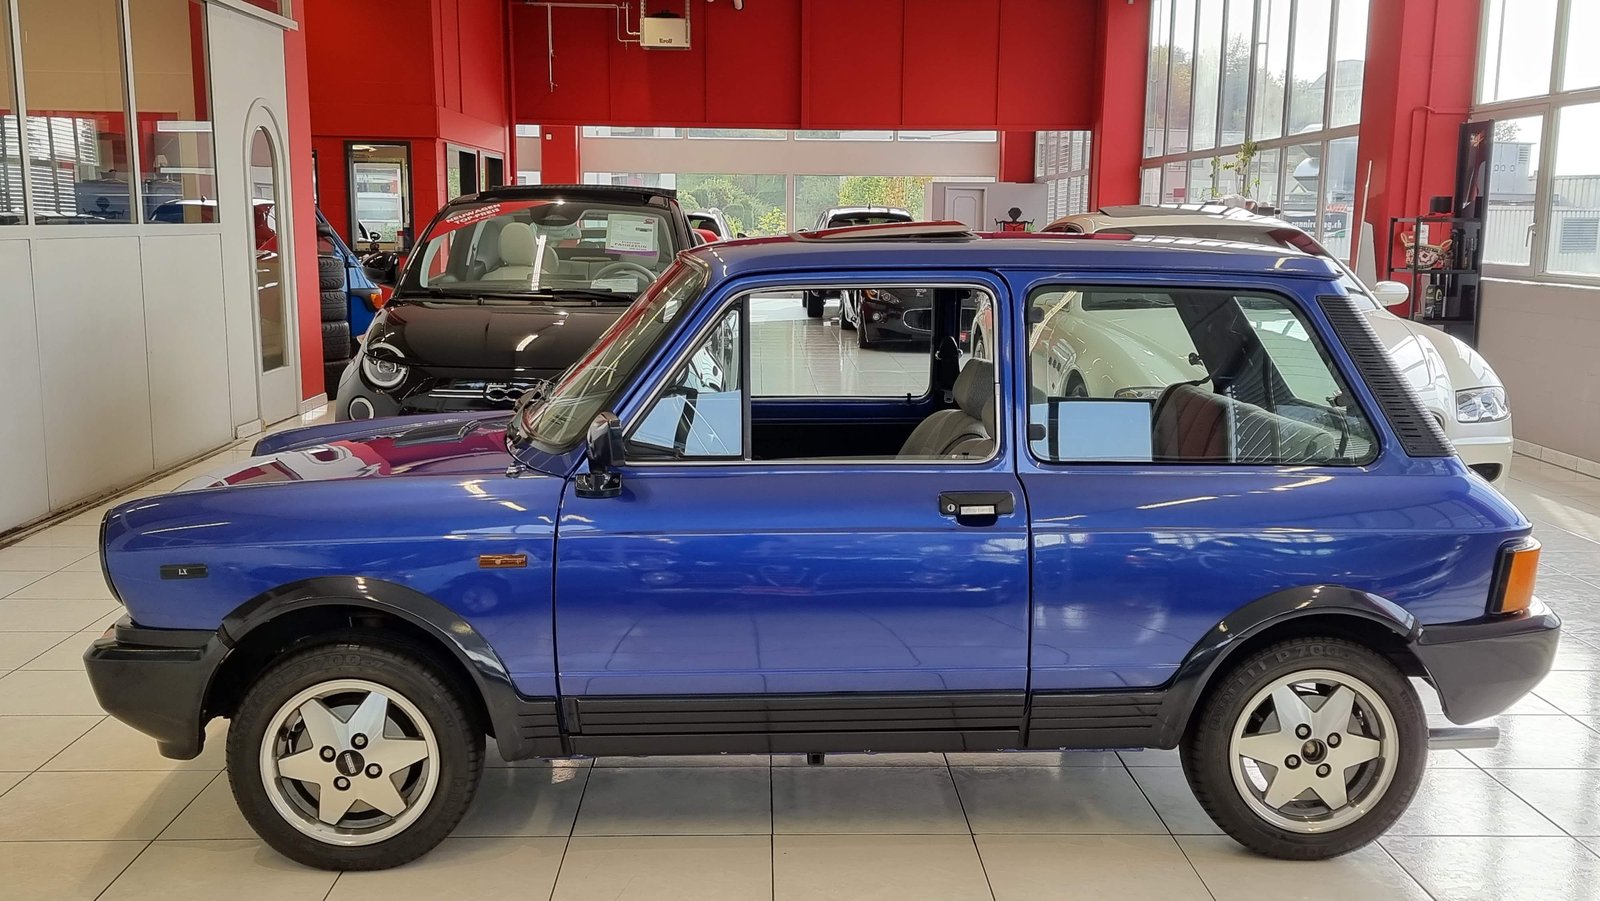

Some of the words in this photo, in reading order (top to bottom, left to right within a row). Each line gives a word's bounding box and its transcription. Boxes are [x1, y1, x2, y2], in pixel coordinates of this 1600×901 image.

[445, 203, 501, 224] NEUWAGEN
[453, 208, 501, 225] TOP-PREIS
[178, 568, 188, 576] LX
